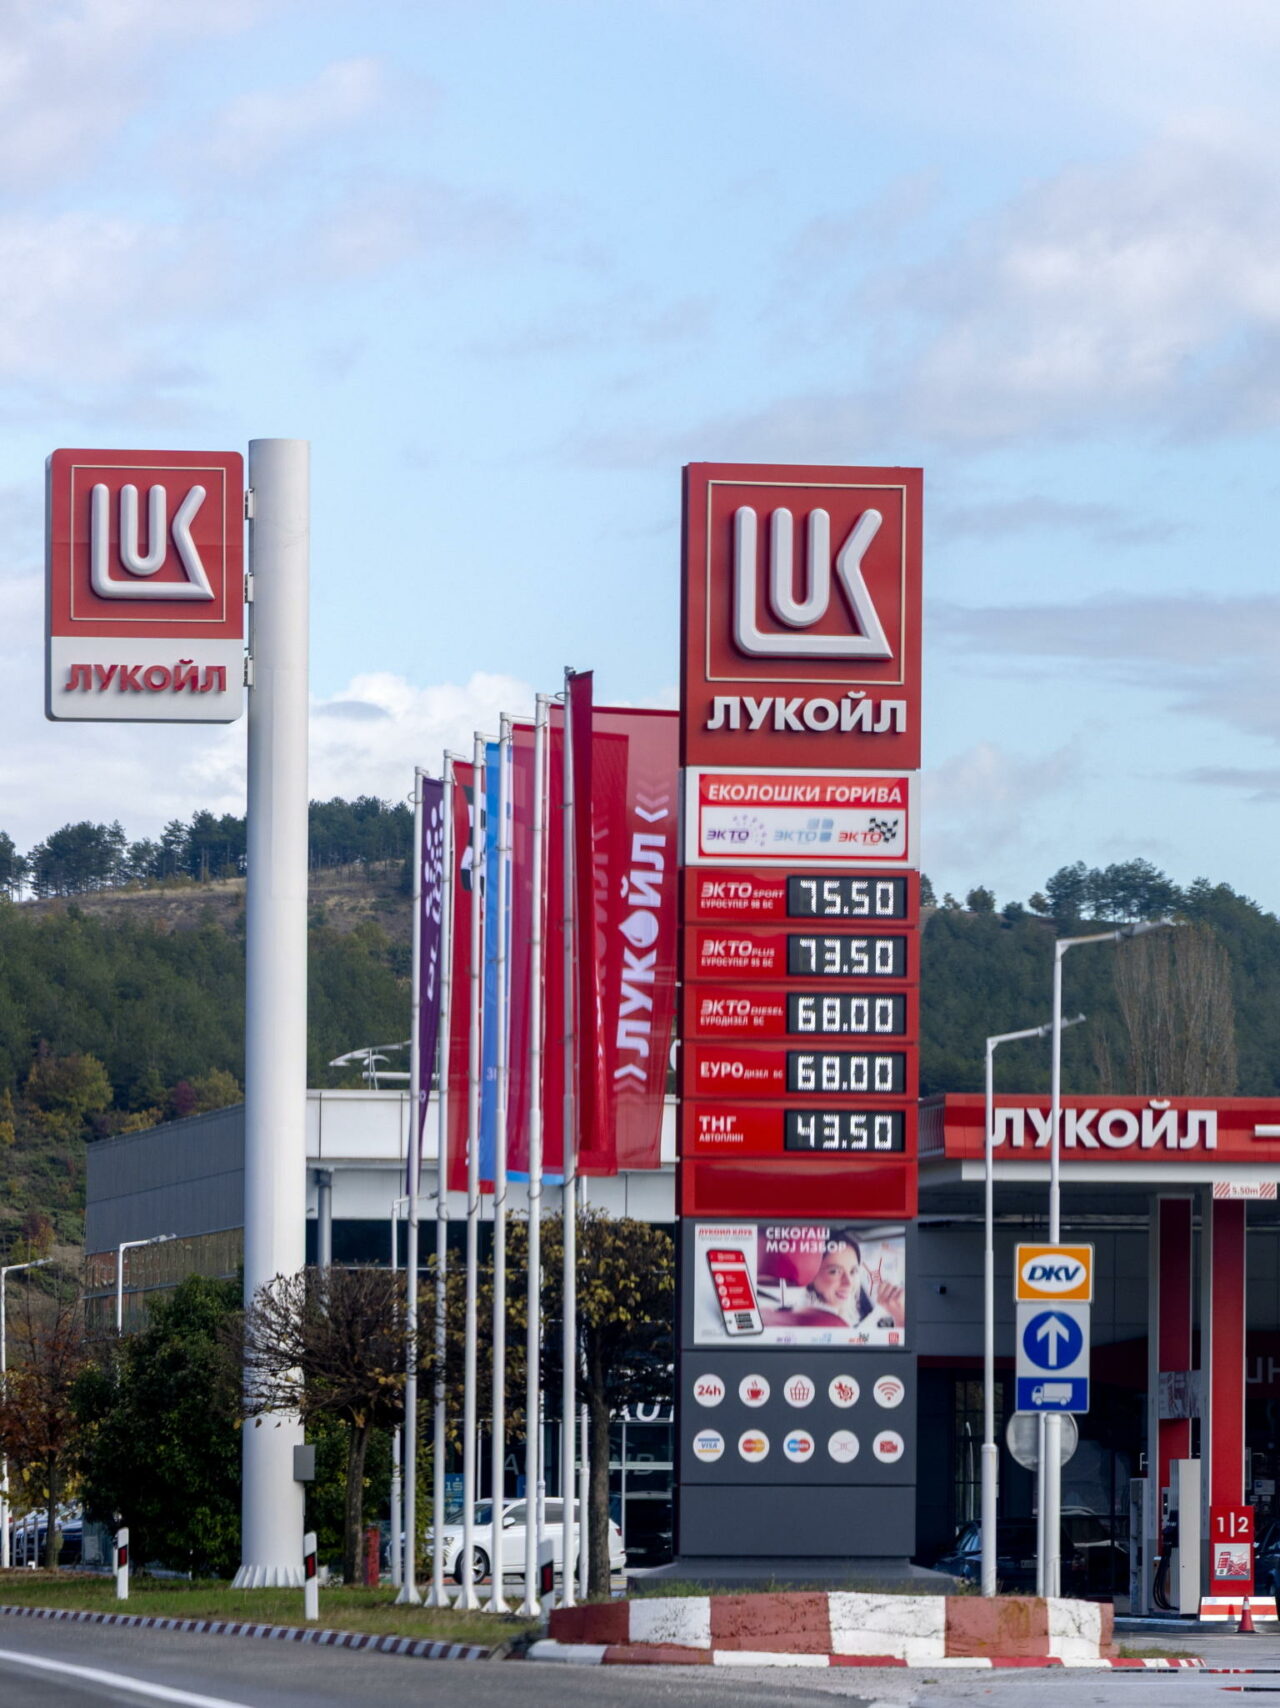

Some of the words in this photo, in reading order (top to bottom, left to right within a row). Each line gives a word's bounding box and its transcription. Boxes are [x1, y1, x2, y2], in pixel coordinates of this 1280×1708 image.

[66, 659, 227, 692] ЛУКОЙЛ
[707, 691, 907, 733] ЛУКОЙЛ
[708, 784, 820, 803] ЕКОЛОШКИ
[826, 786, 902, 803] ГОРИВА
[701, 882, 752, 898] ЭКТО
[799, 880, 894, 915] 75.50
[701, 940, 752, 956] ЭКТО
[799, 938, 894, 974] 73.50
[701, 999, 750, 1016] ЭКТО
[798, 997, 893, 1032] 68.00
[700, 1062, 744, 1078] ЕУРО
[797, 1055, 893, 1091] 68.00
[699, 1116, 736, 1132] ТНГ
[797, 1114, 893, 1149] 43.50
[992, 1099, 1218, 1150] ЛУКОЙЛ
[699, 1133, 744, 1143] АВТОПЛИН
[766, 1227, 830, 1240] СЕКОГАШ
[766, 1241, 796, 1253] МОЈ
[800, 1241, 846, 1253] ИЗБОР
[1027, 1265, 1081, 1282] DKV
[697, 1384, 721, 1396] 24h
